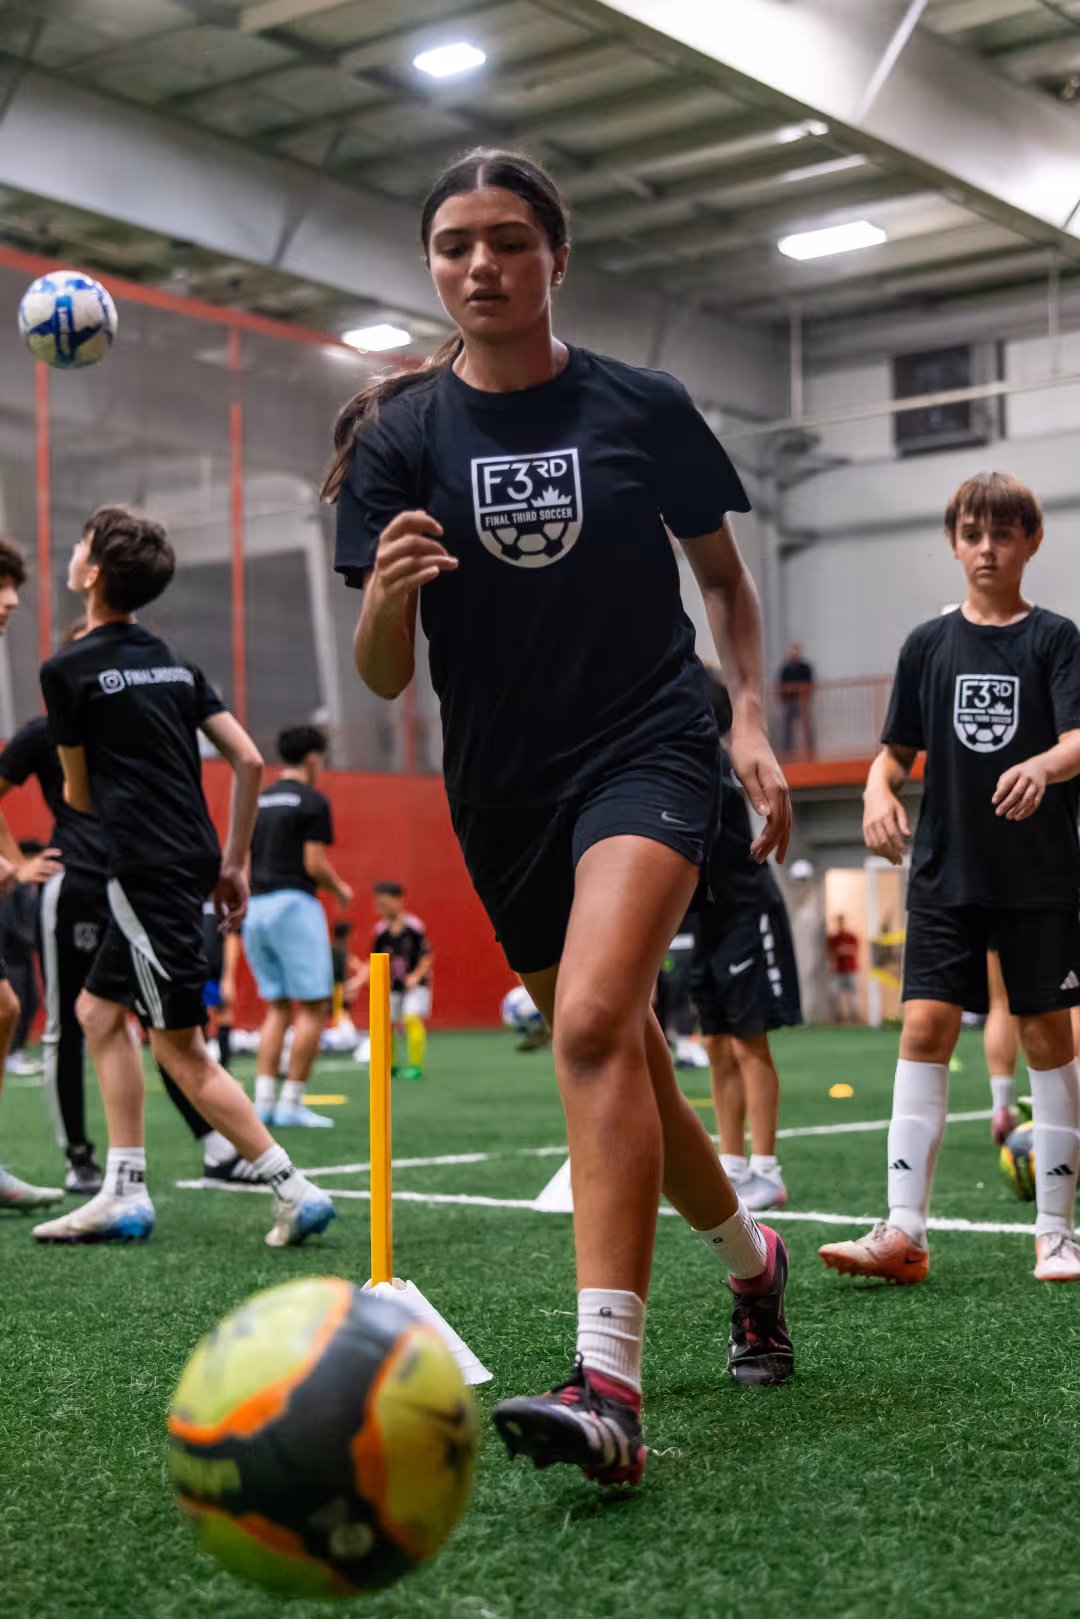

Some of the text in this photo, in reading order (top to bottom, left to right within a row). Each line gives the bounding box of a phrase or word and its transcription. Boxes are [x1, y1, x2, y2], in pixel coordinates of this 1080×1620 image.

[483, 459, 567, 504] F3RD
[485, 507, 573, 527] FINAL THIRD SOCCER
